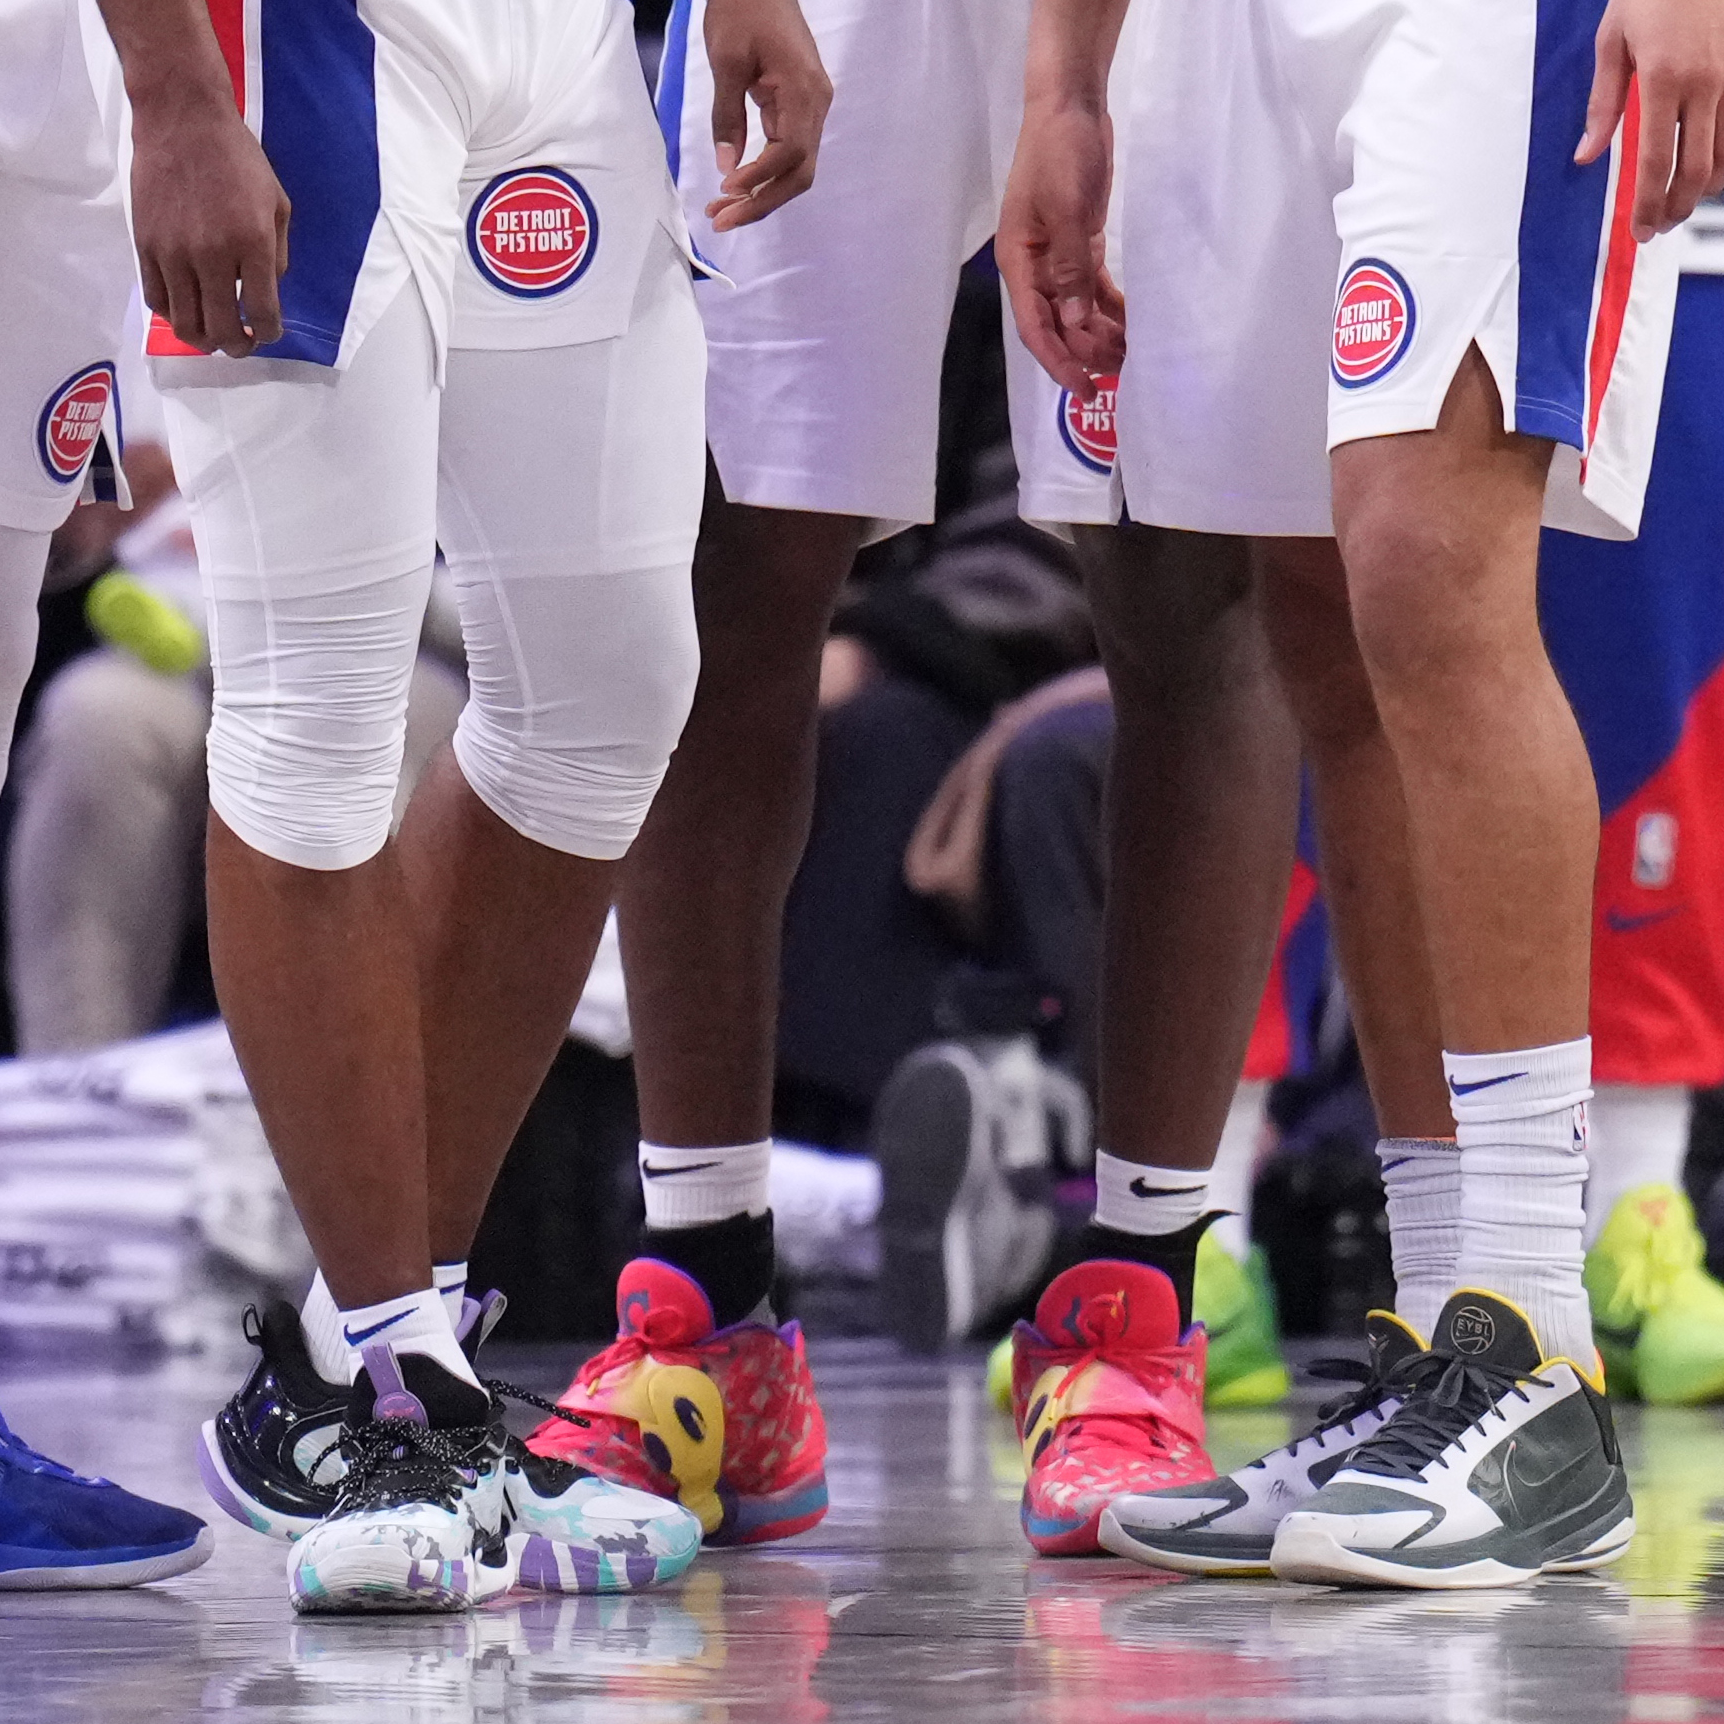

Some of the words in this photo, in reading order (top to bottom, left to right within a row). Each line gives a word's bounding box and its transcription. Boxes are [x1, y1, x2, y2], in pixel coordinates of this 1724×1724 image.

[494, 207, 571, 232] DETROIT
[494, 229, 574, 254] PISTONS
[1340, 299, 1393, 327] DETROIT
[1338, 320, 1393, 349] PISTONS
[1457, 1317, 1490, 1336] EYBL
